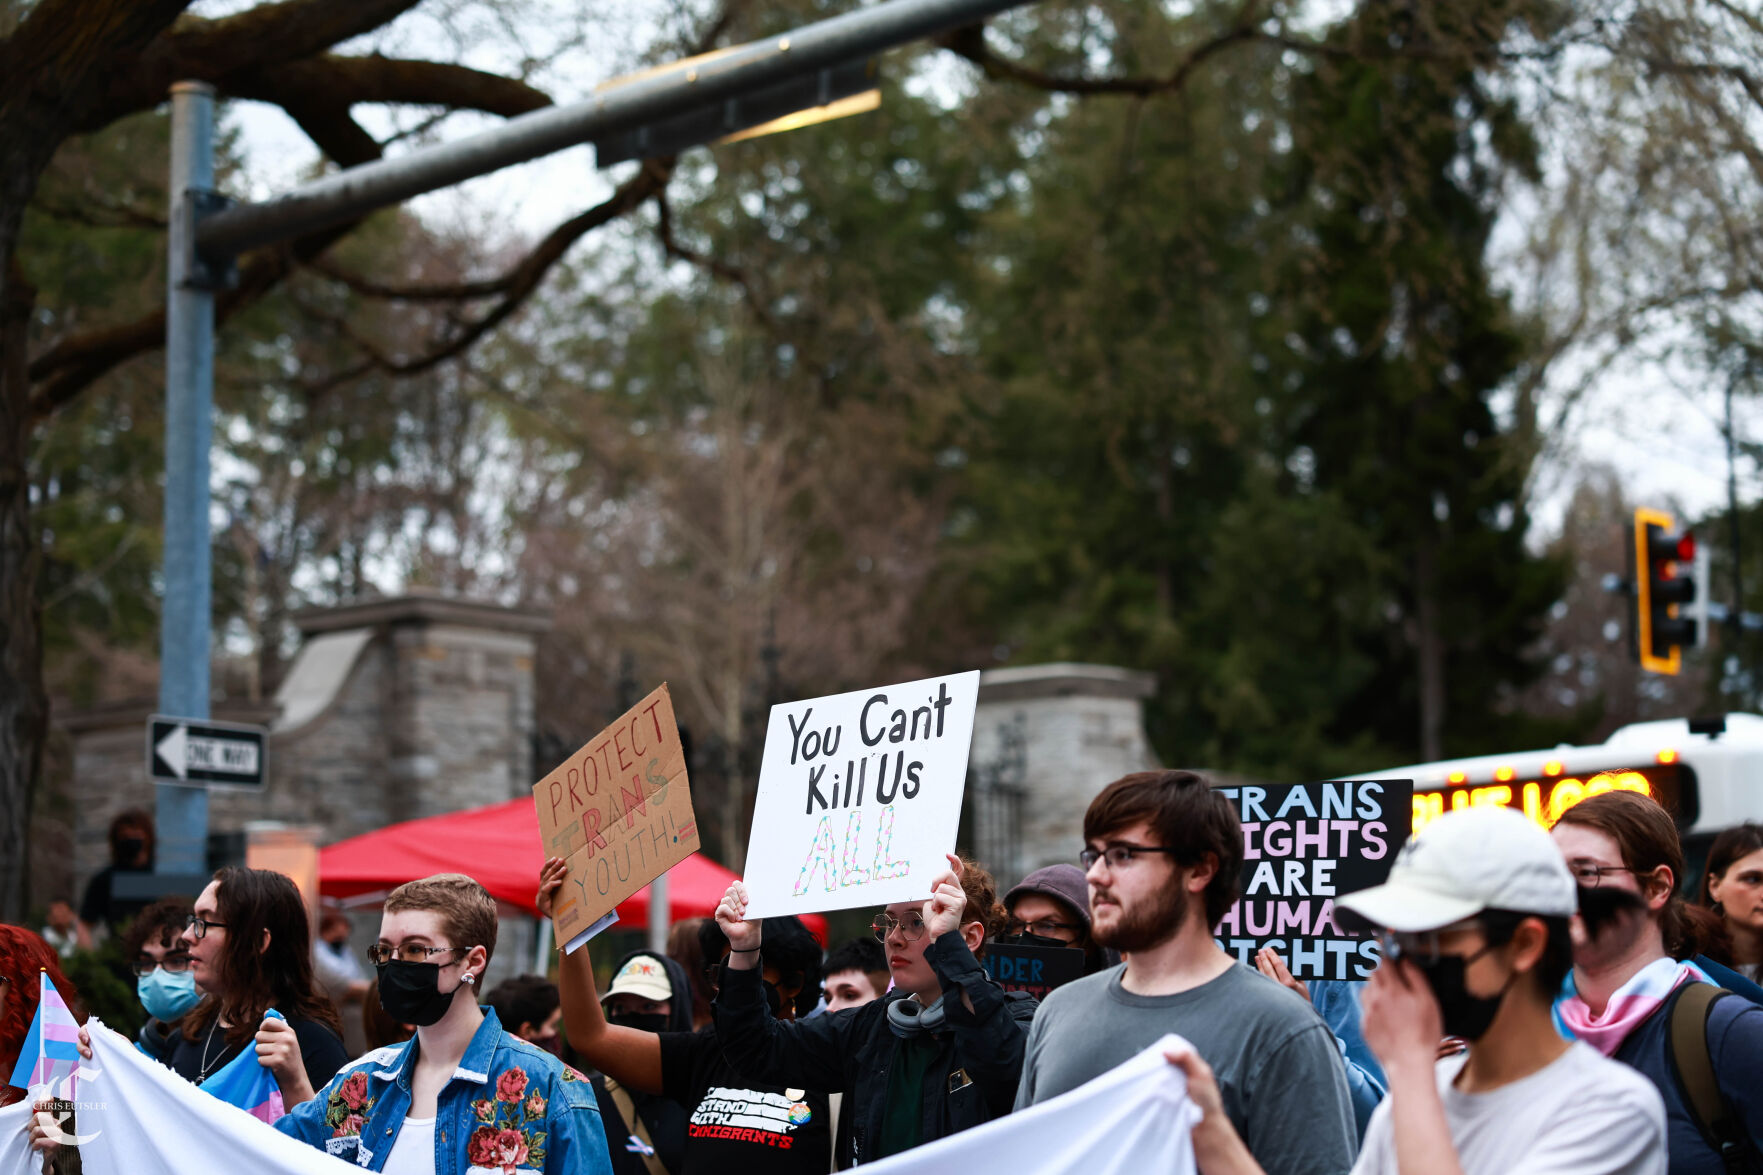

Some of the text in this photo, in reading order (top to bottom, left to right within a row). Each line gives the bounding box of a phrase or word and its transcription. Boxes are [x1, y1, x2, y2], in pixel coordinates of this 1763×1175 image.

[788, 683, 953, 765] You Can't
[549, 699, 663, 827] PROTECT
[806, 750, 924, 815] Kill Us
[551, 757, 670, 875] TRANS
[1240, 819, 1388, 861] IGHTS
[574, 809, 678, 906] YOUTH!
[792, 805, 911, 897] ALL
[1246, 859, 1337, 897] ARE
[1213, 898, 1379, 937] HUMA
[689, 1111, 731, 1126] WITH
[696, 1099, 748, 1114] STAND
[688, 1123, 794, 1150] IMMIGRANTS
